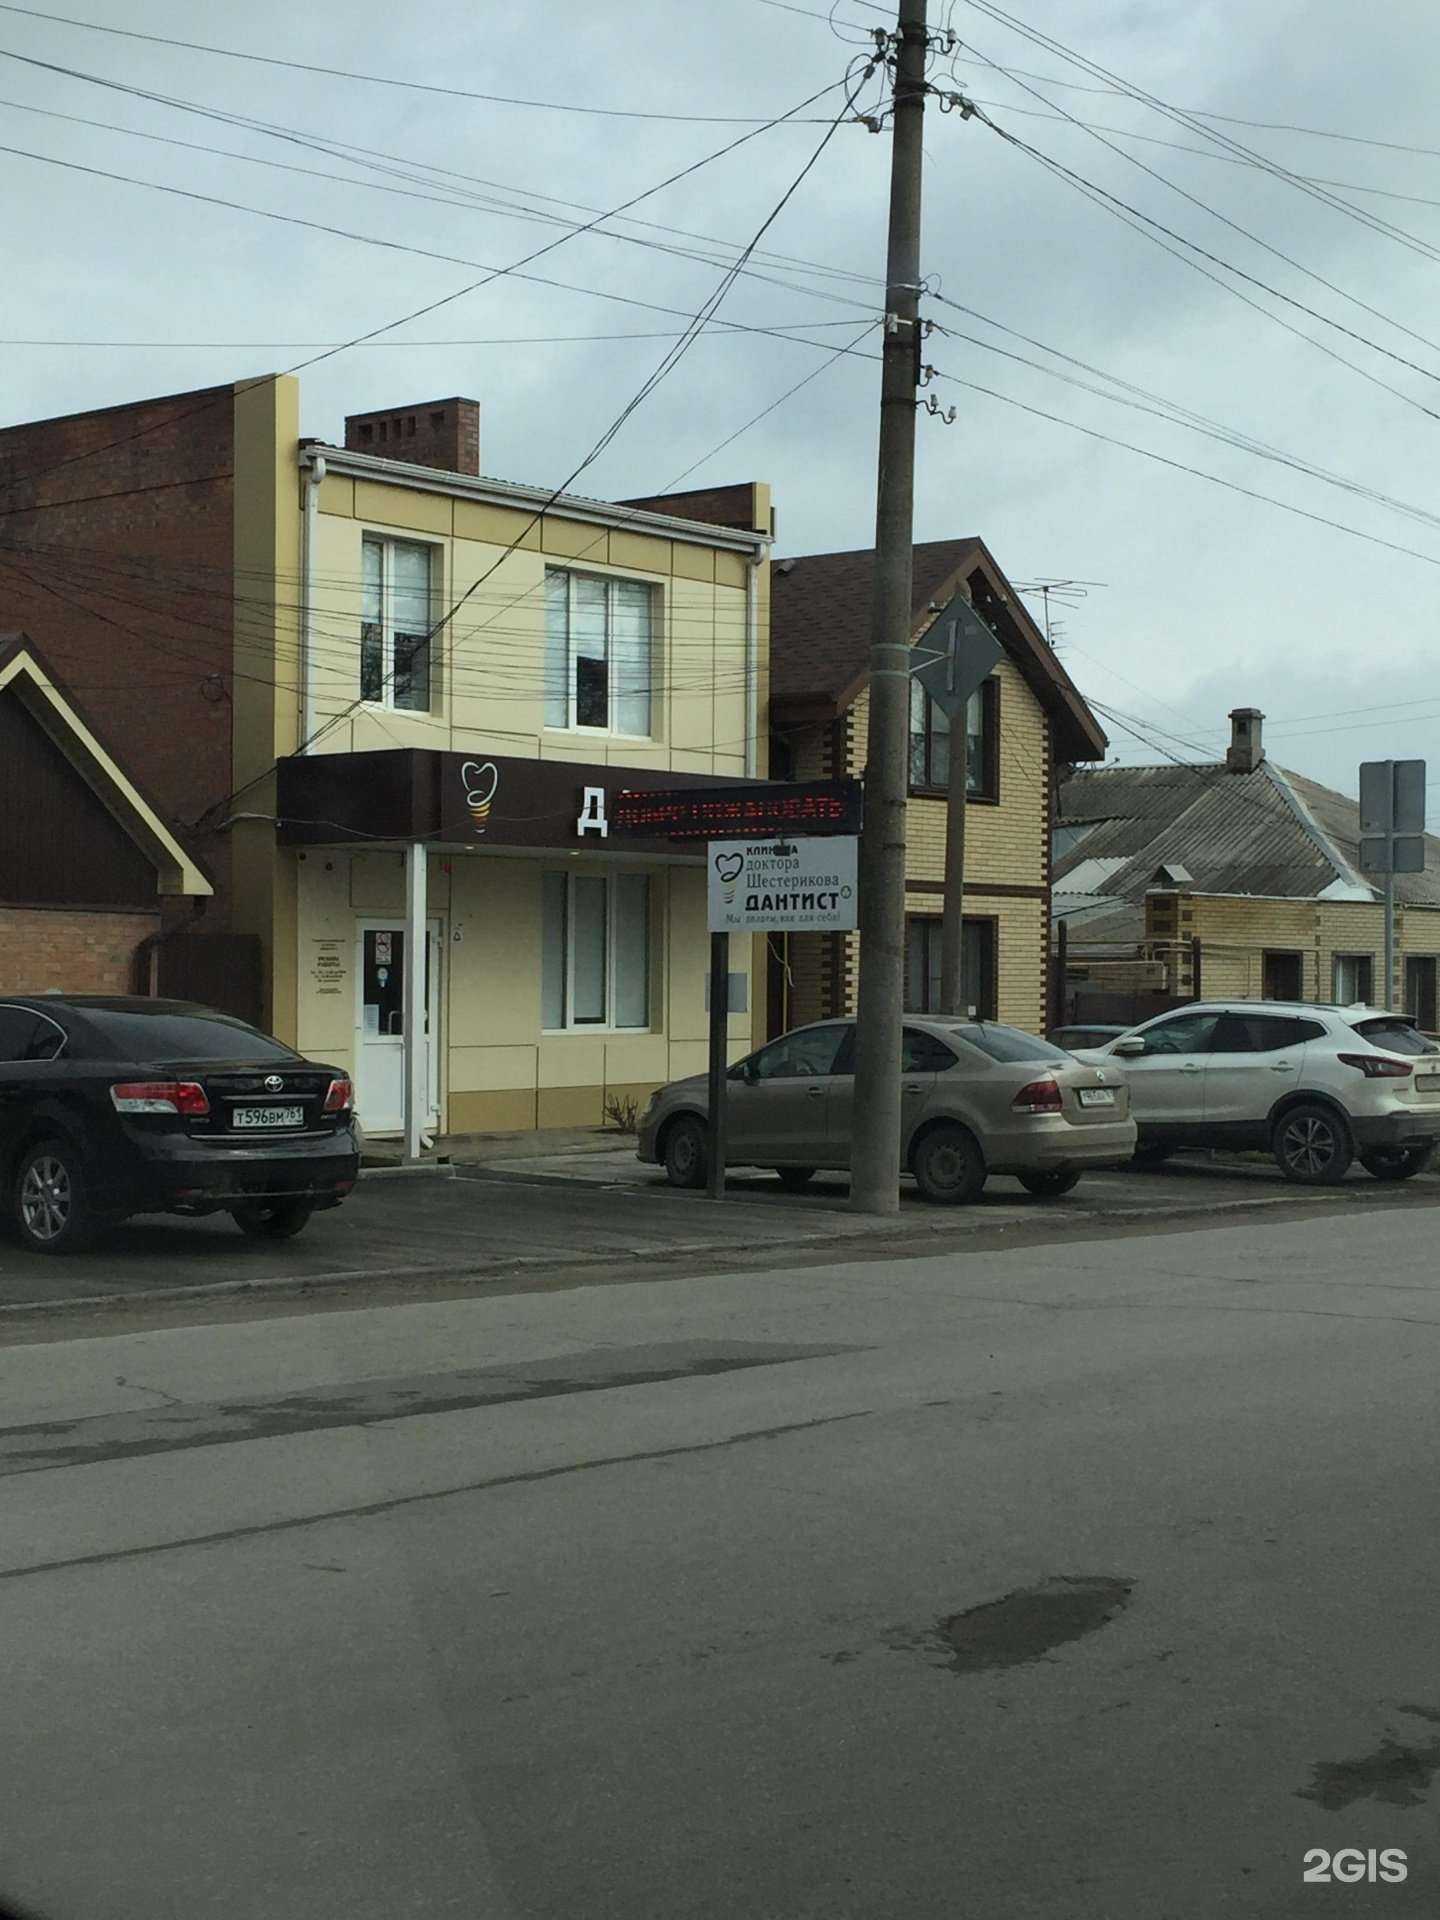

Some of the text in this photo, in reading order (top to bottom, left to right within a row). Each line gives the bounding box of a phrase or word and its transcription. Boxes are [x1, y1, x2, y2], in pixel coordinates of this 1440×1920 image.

[746, 844, 798, 857] КЛИНА
[746, 858, 800, 874] доктора
[746, 873, 840, 892] Шестерикова
[745, 892, 840, 912] ДАНТИСТ
